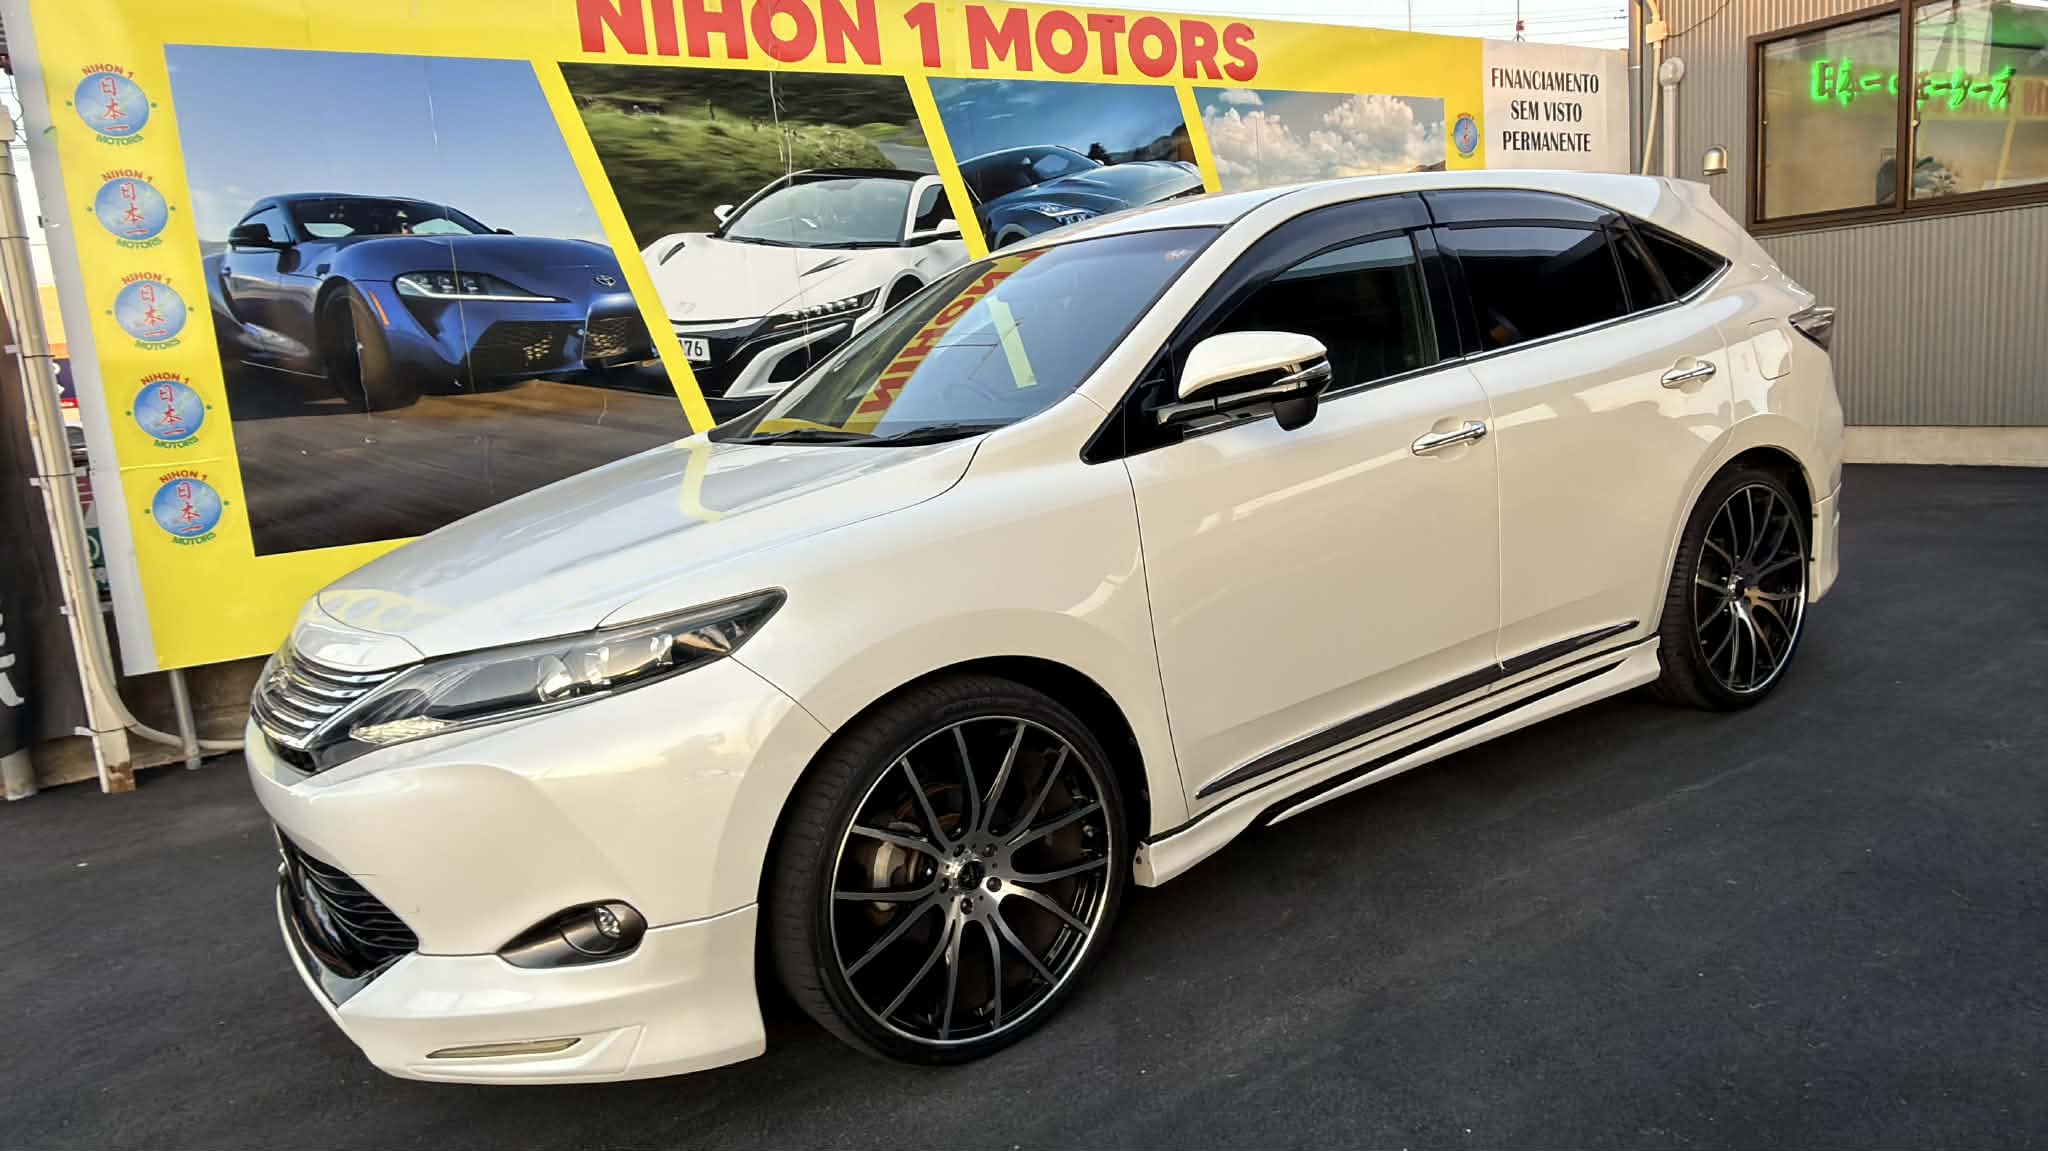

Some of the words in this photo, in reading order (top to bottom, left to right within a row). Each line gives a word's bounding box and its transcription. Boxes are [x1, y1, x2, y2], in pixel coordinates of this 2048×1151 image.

[576, 0, 882, 66] NIHON
[904, 2, 942, 68] 1
[965, 5, 1259, 82] MOTORS
[81, 63, 124, 76] NIHON
[1491, 67, 1600, 94] FINANCIAMENTO
[1511, 100, 1539, 121] SEM
[1543, 102, 1583, 122] VISTO
[96, 135, 145, 146] MOTORS
[1502, 130, 1592, 152] PERMANENTE
[101, 169, 144, 182] NIHON
[116, 238, 163, 250] MOTORS
[121, 272, 163, 285] NIHON
[134, 338, 181, 350] MOTORS
[140, 372, 181, 386] NIHON
[153, 436, 199, 449] MOTORS
[159, 470, 198, 483] NIHON
[171, 532, 217, 545] MOTORS
